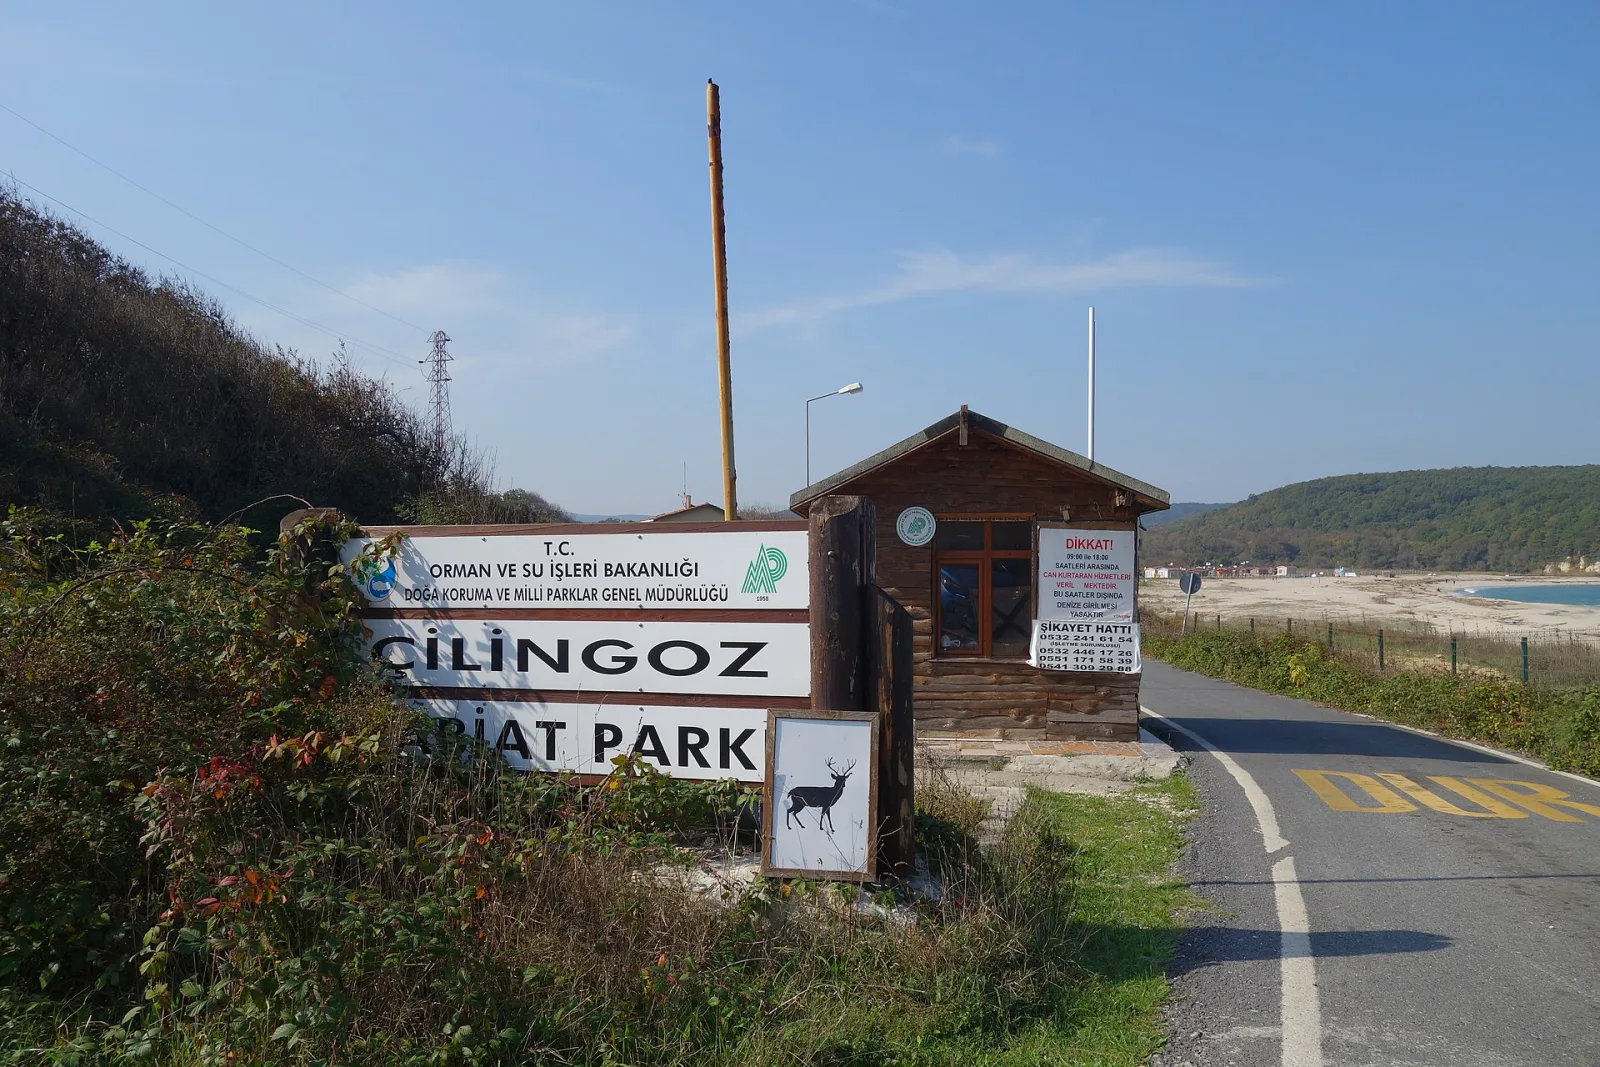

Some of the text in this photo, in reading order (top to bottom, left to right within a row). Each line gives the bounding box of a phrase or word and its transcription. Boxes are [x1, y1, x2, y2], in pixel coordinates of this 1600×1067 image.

[544, 541, 574, 556] T.C.
[1066, 536, 1114, 550] DİKKAT!
[430, 558, 698, 582] ORMAN VE SU İŞLERİ BAKANLIĞI
[405, 584, 728, 602] DOĞA KORUMA VE MİLLİ PARKLAR GENEL MÜDÜRLÜĞÜ
[1096, 592, 1123, 600] DIŞINDA
[1040, 621, 1131, 634] ŞİKAYET HATTI
[371, 628, 768, 679] ÇİLİNGOZ
[1291, 769, 1600, 823] DUR
